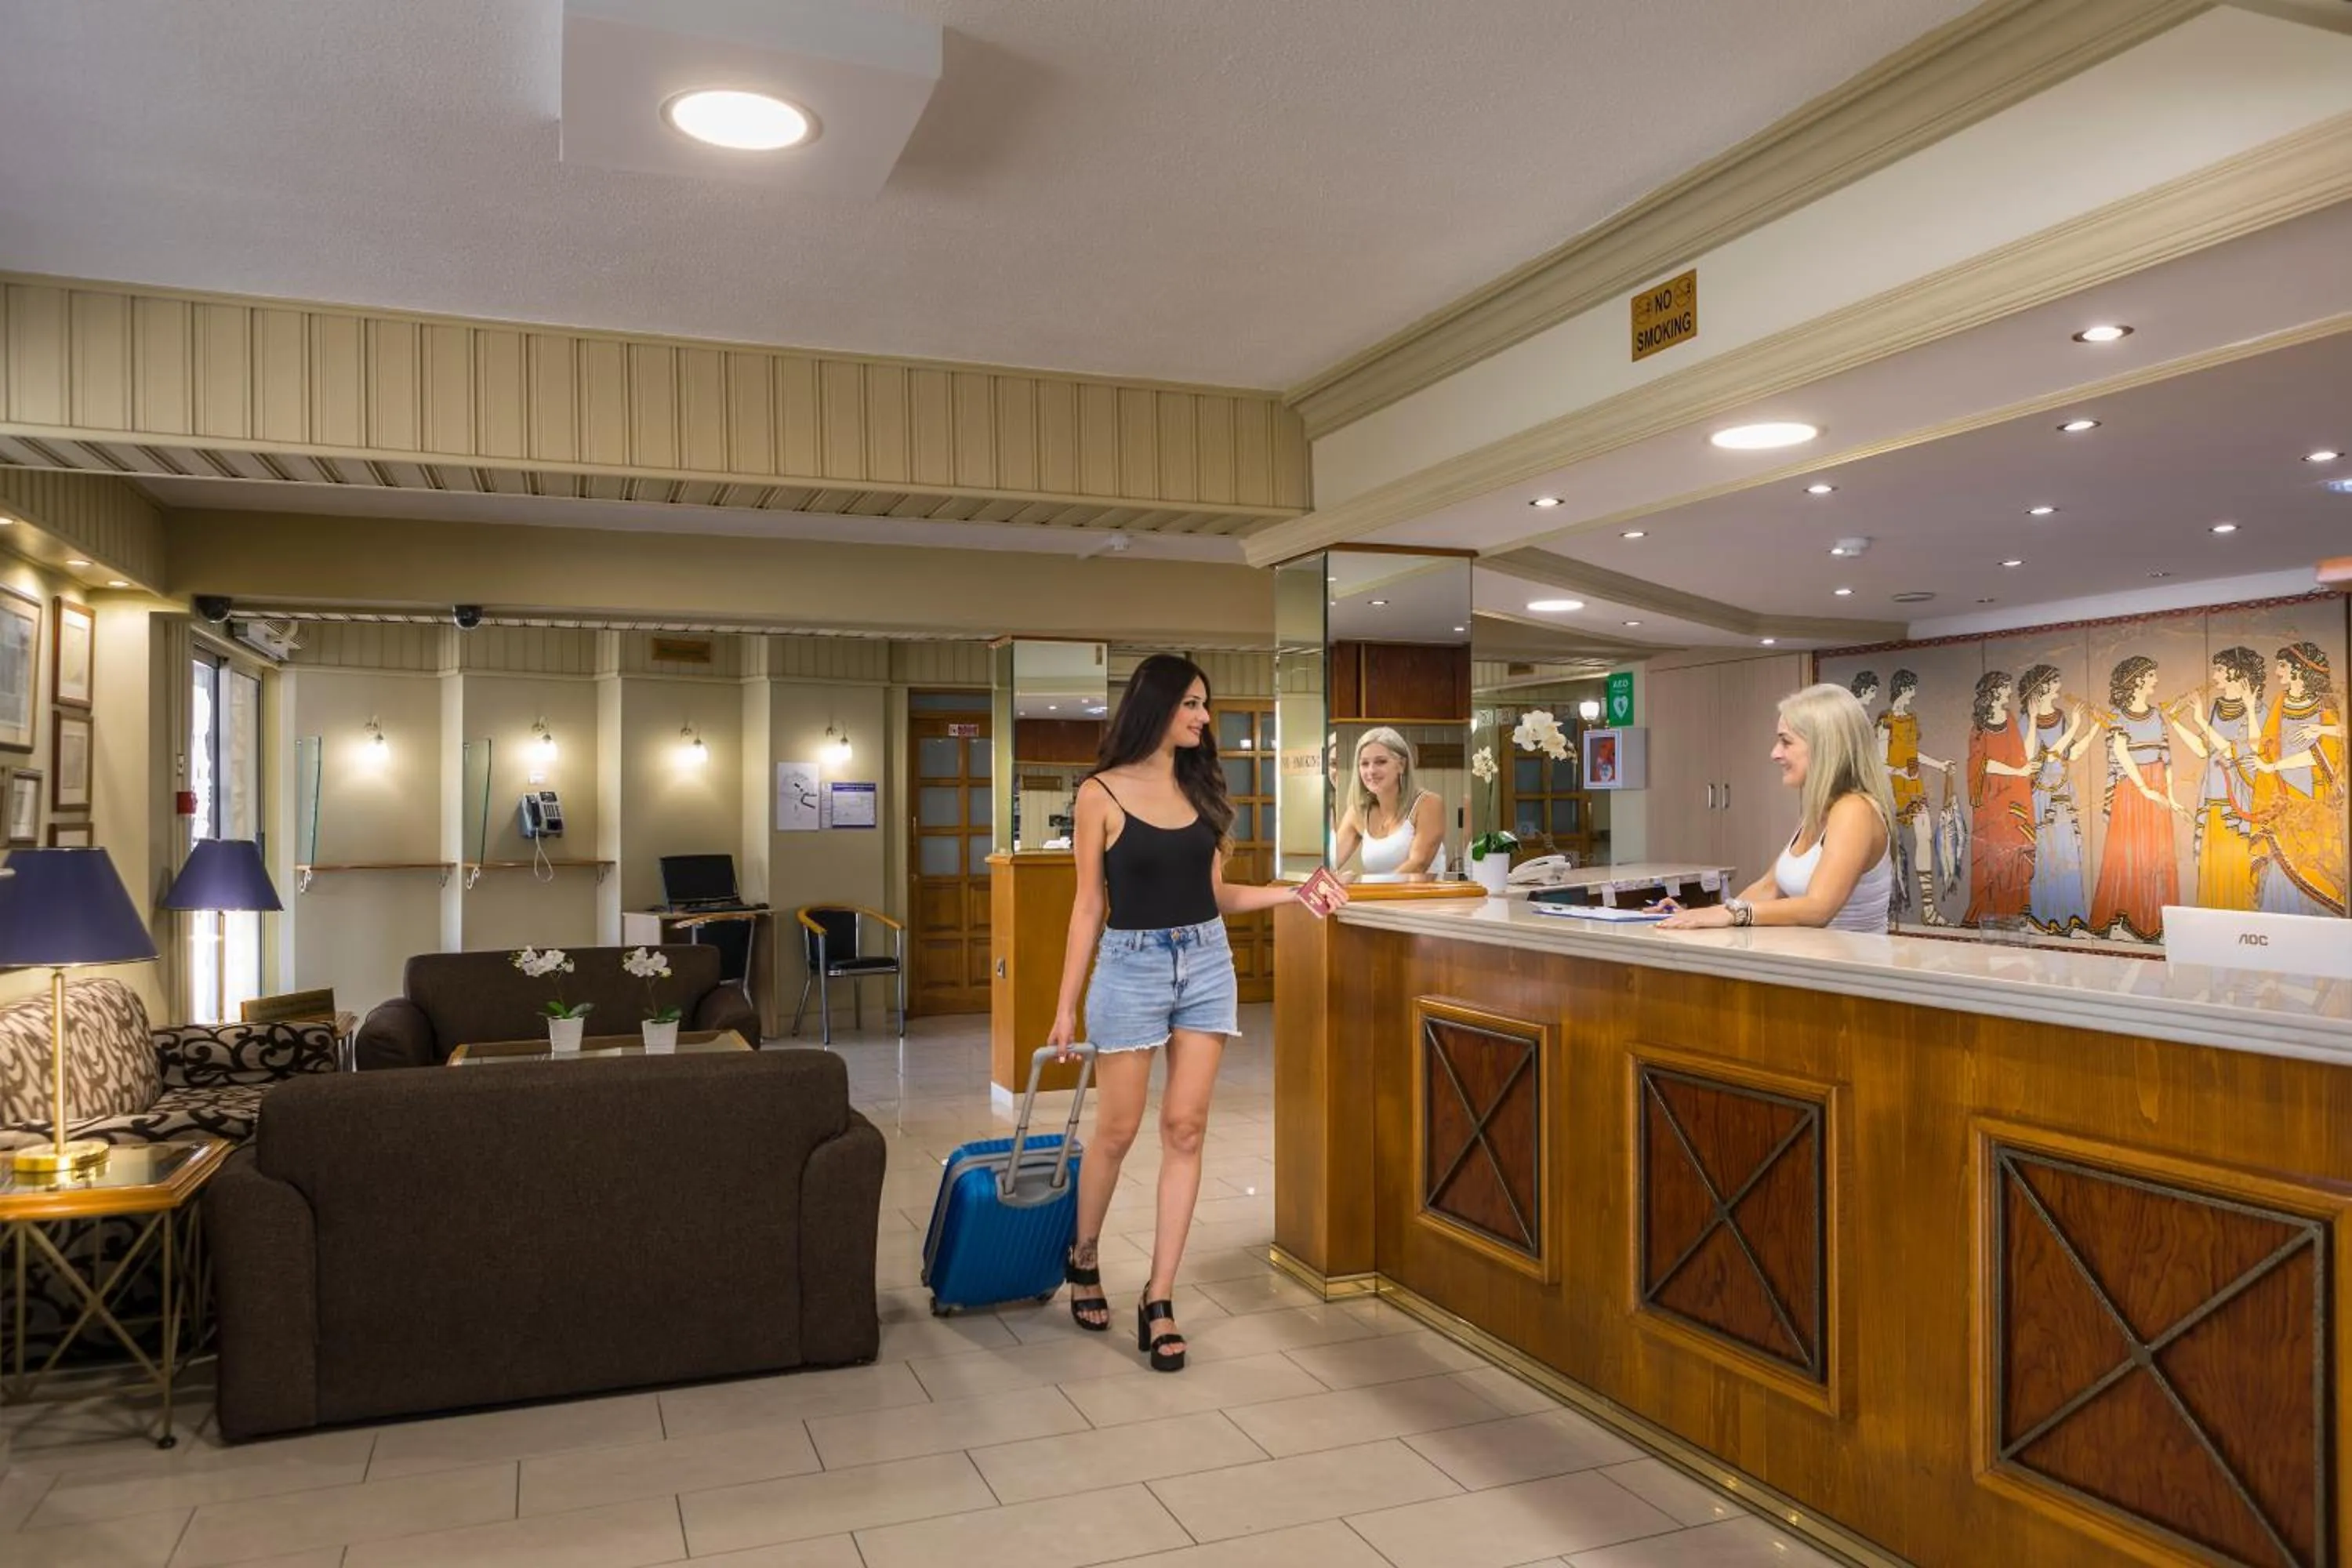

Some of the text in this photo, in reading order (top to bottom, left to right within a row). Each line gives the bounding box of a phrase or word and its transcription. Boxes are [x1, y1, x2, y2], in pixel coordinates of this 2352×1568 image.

[1654, 289, 1672, 315] NO
[1637, 311, 1691, 352] SMOKING
[2238, 934, 2268, 946] AOC
